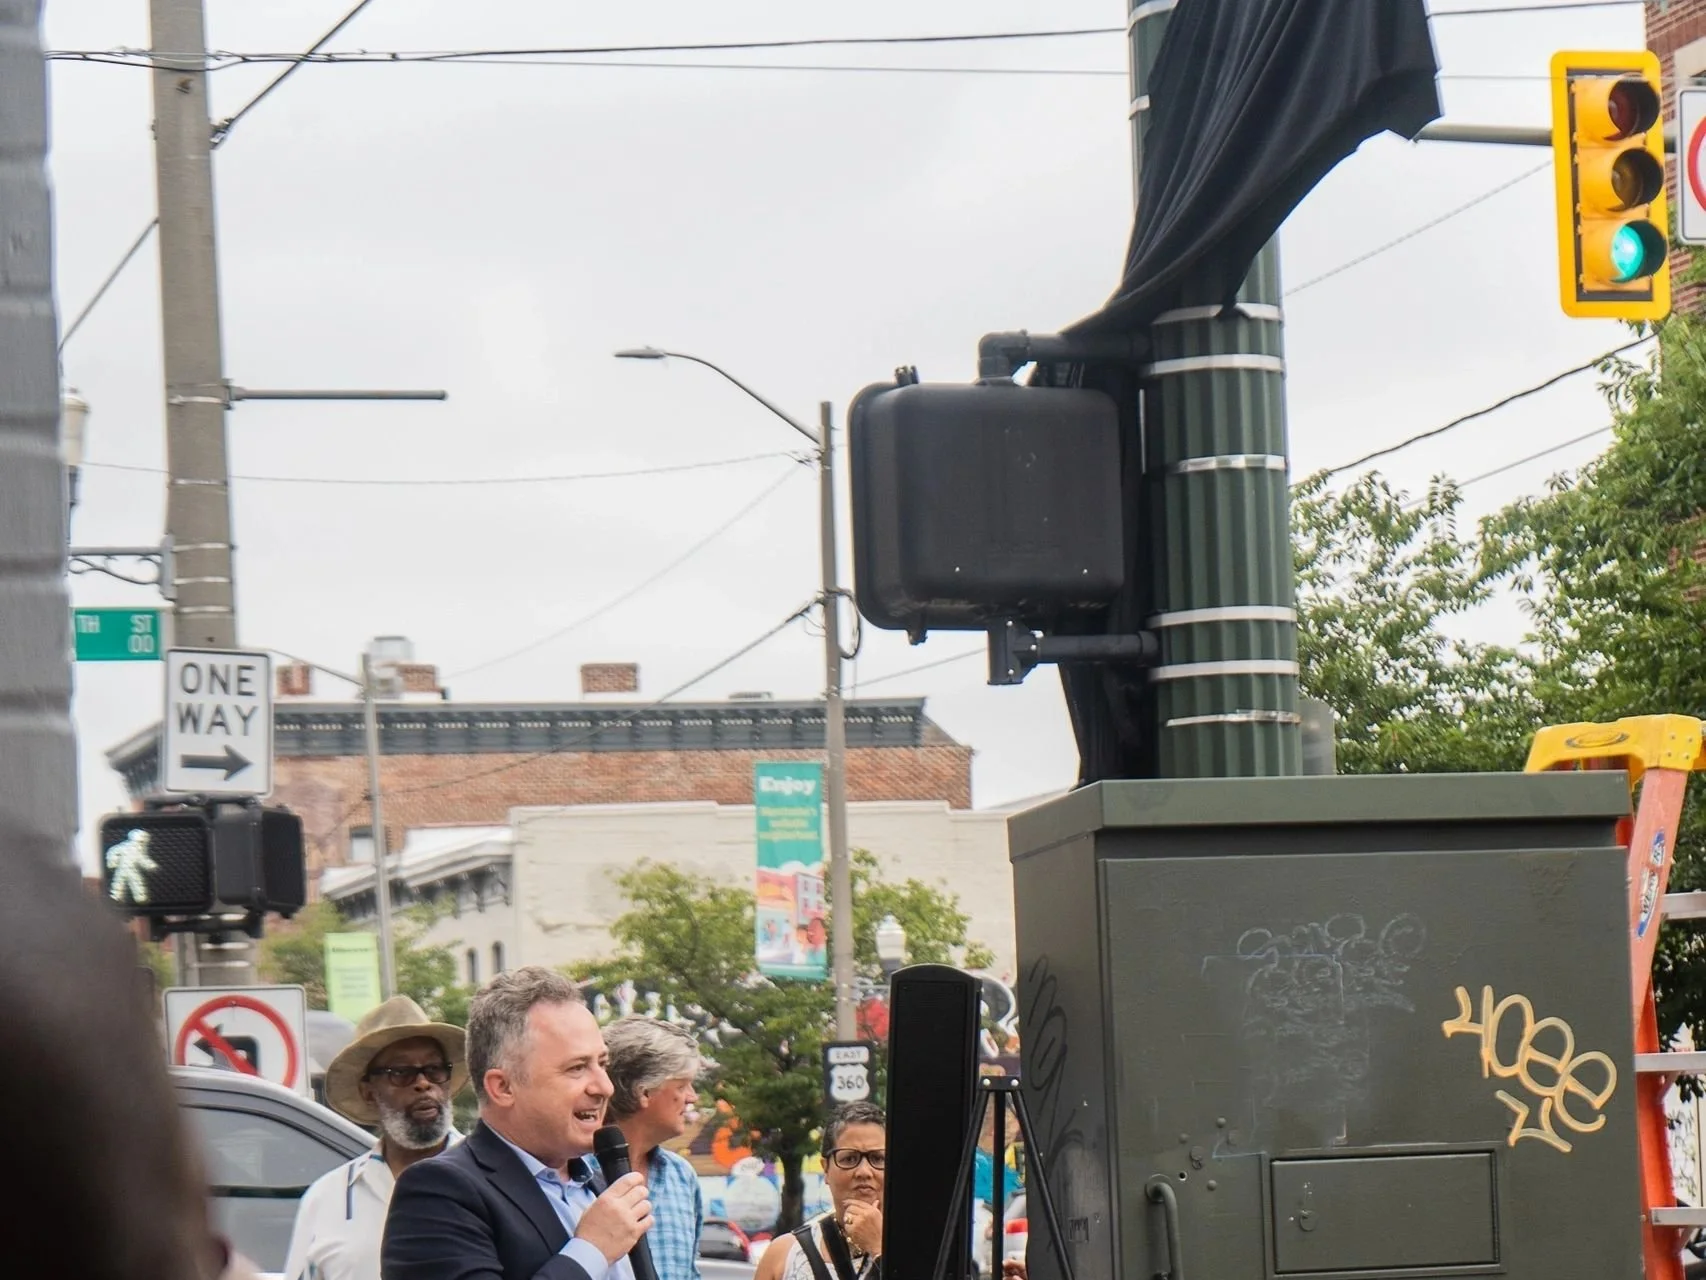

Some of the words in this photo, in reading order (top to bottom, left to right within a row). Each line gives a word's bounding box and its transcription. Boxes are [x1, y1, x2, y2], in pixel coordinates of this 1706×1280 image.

[130, 614, 153, 633] ST
[180, 662, 256, 696] ONE
[176, 702, 259, 736] WAY
[759, 775, 816, 796] Enjoy
[837, 1075, 865, 1090] 360
